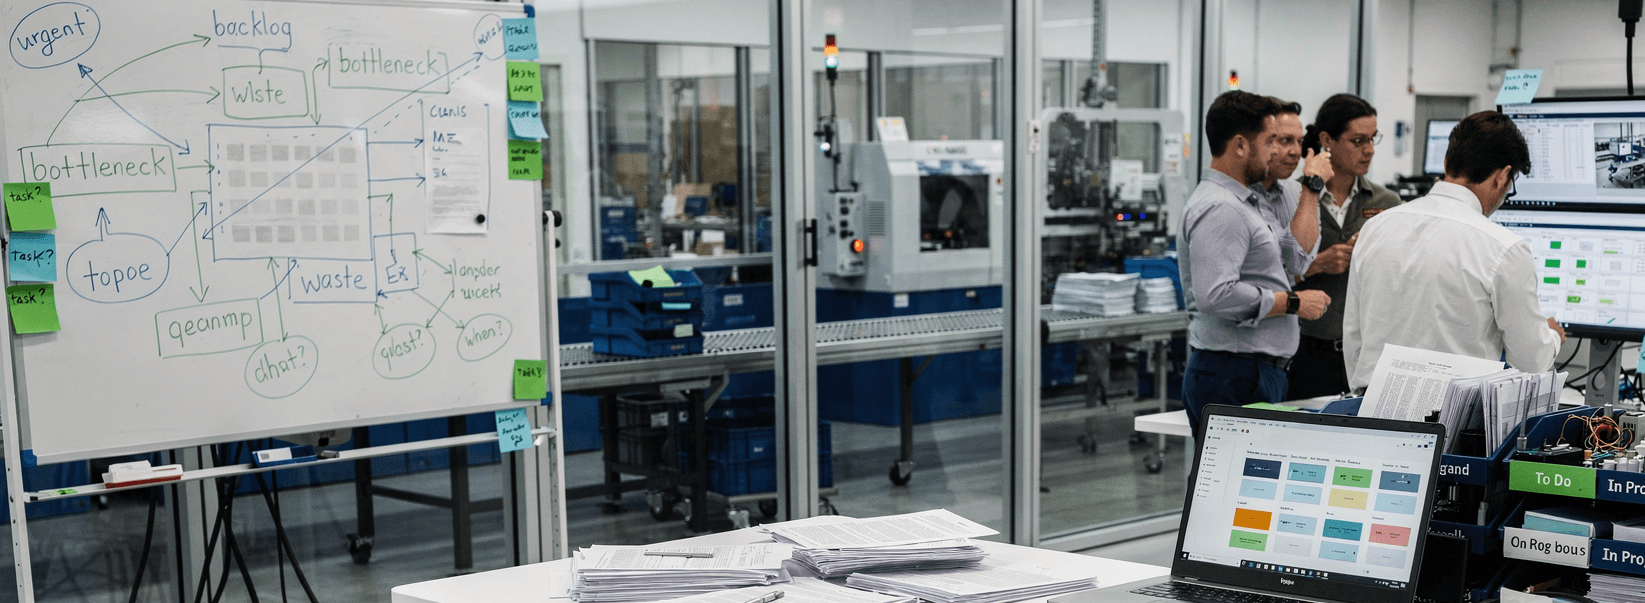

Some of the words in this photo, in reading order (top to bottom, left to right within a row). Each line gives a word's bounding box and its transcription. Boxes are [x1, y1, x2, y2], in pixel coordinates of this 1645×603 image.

[17, 12, 86, 56] urgent
[213, 10, 292, 49] backlog
[339, 46, 438, 76] bottleneck
[30, 148, 167, 182] bottleneck
[9, 186, 42, 203] task?
[11, 288, 46, 305] task?
[465, 320, 504, 347] when?
[1535, 472, 1550, 485] To
[1554, 474, 1571, 487] Do
[1607, 478, 1622, 493] In
[1511, 536, 1527, 549] On
[1530, 538, 1552, 554] Rog
[1602, 547, 1618, 562] In
[1622, 550, 1645, 568] Pro
